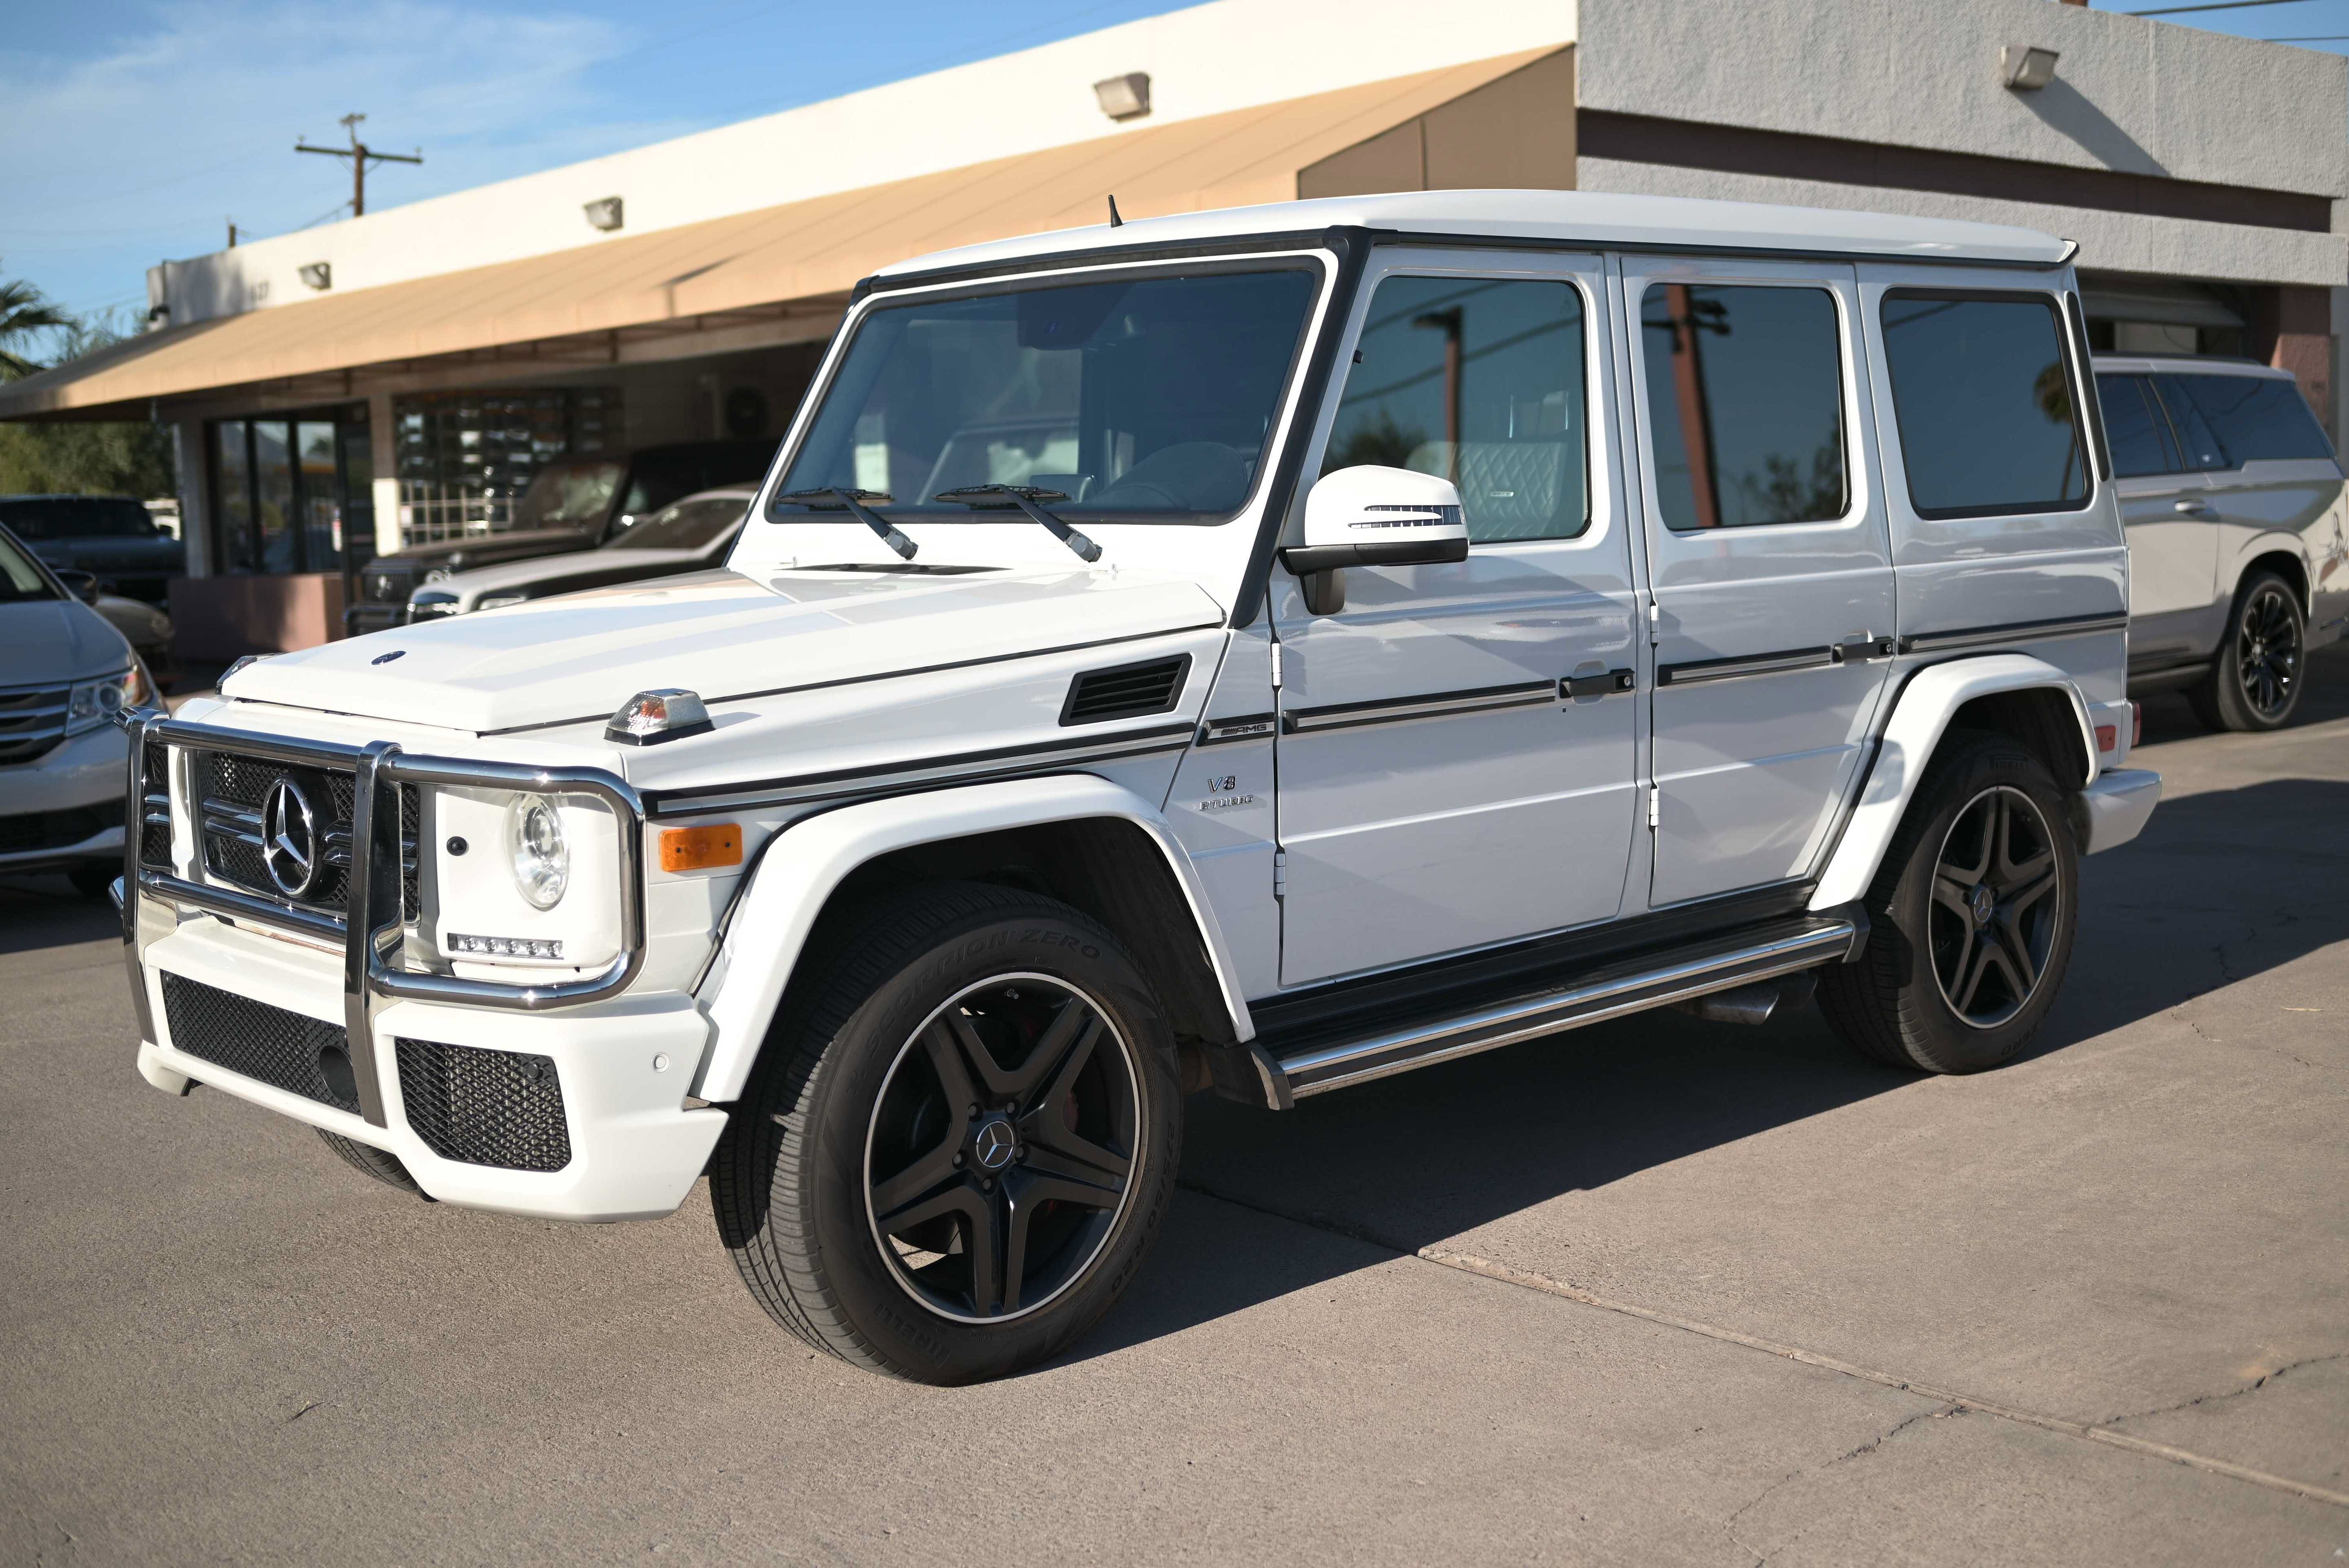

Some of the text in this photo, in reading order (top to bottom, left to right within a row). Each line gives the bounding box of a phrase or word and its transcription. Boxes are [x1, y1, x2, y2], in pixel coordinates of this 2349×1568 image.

[1235, 724, 1267, 734] AMG
[1208, 776, 1236, 793] V8
[1199, 795, 1254, 811] BITURBO
[867, 929, 1010, 1059] SCORPION
[1019, 929, 1101, 960] ZERO
[1110, 1121, 1175, 1293] 275/50 R20
